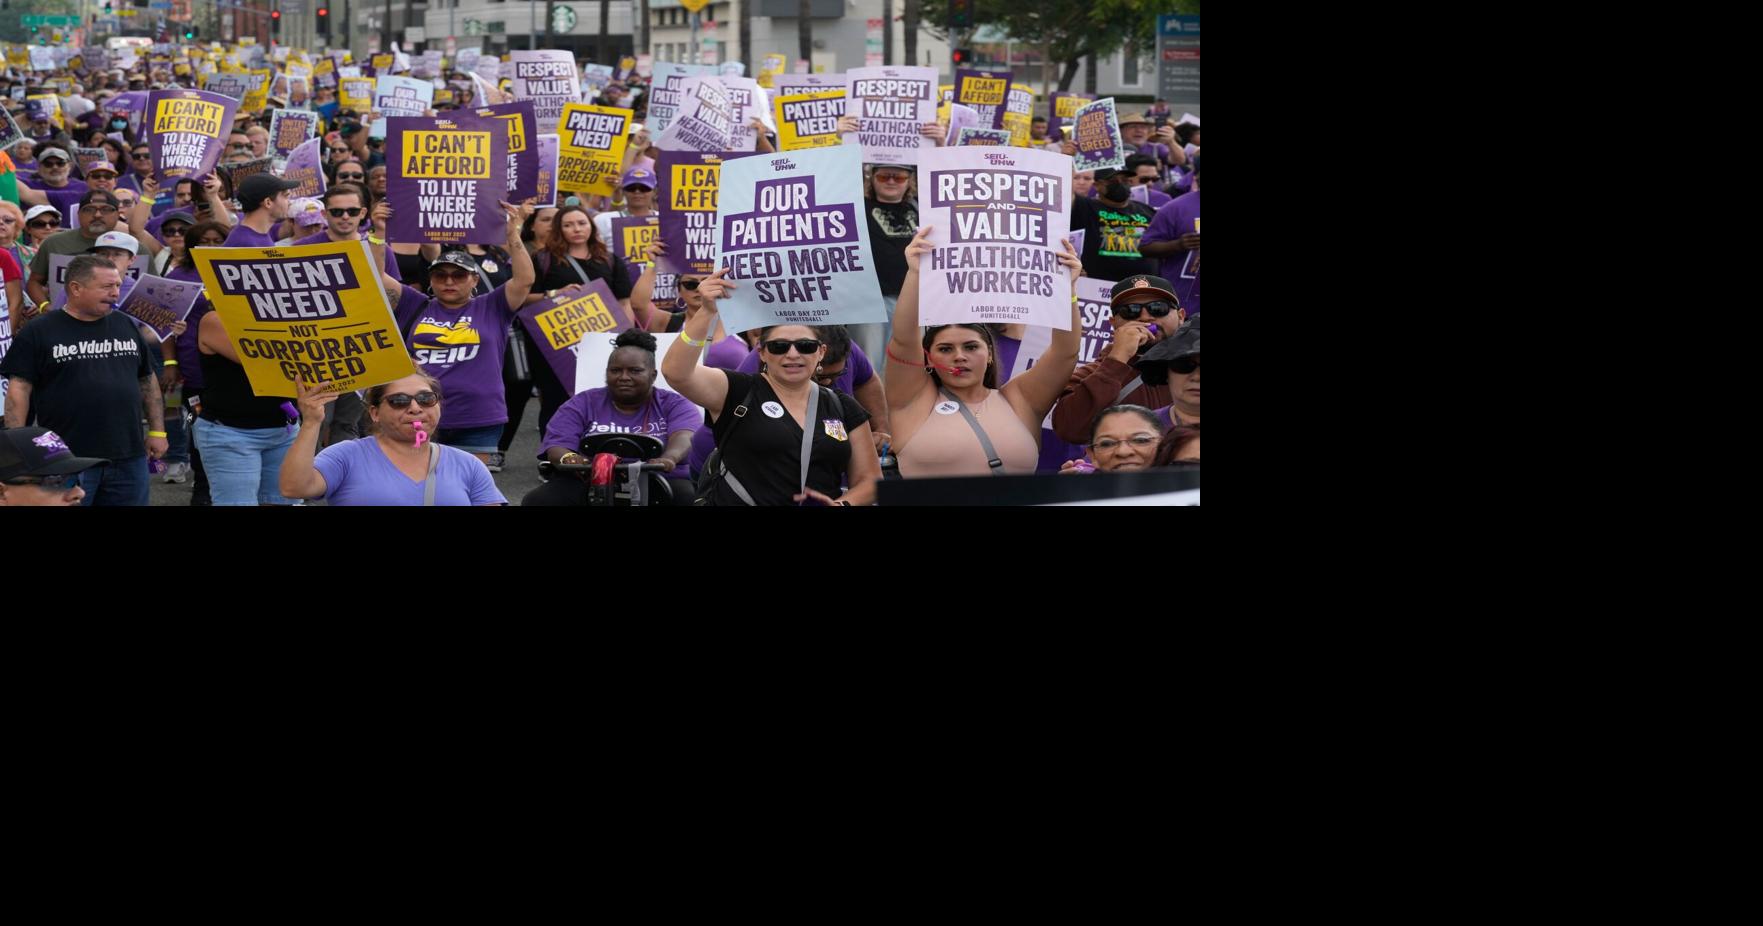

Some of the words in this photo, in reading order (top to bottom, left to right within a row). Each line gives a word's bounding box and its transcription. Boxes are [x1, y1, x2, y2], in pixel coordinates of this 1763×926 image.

[528, 80, 570, 95] VALUE
[856, 80, 928, 98] RESPECT
[164, 101, 169, 114] I
[172, 101, 220, 119] CAN'T
[784, 99, 846, 120] PATIENT
[865, 101, 915, 119] VALUE
[158, 116, 216, 134] AFFORD
[568, 112, 624, 134] PATIENT
[676, 116, 728, 149] HEALTHCAR
[796, 116, 837, 136] NEED
[860, 120, 922, 135] EALTHCAR
[162, 133, 176, 144] TO
[180, 134, 208, 146] LIVE
[414, 134, 420, 152] I
[425, 134, 485, 154] CAN'T
[572, 130, 611, 149] NEED
[858, 134, 920, 149] WORKERS
[1080, 139, 1112, 152] GREED
[162, 144, 204, 158] WHERE
[160, 157, 164, 168] I
[166, 156, 202, 170] WORK
[407, 156, 486, 176] AFFORD
[558, 156, 619, 175] ORPORATE
[558, 169, 600, 184] GREED
[682, 168, 686, 186] I
[418, 180, 438, 196] TO
[442, 180, 477, 196] LIVE
[760, 182, 808, 213] OUR
[938, 173, 1057, 206] RESPECT
[418, 196, 476, 212] WHERE
[676, 189, 718, 208] AFFO
[986, 202, 1016, 210] AND
[419, 212, 424, 228] I
[428, 212, 476, 228] WORK
[684, 212, 704, 228] TO
[730, 210, 846, 246] PATIENTS
[955, 212, 1043, 242] VALUE
[632, 230, 636, 243] I
[686, 244, 690, 260] I
[694, 244, 716, 260] WO
[722, 251, 782, 280] NEED
[788, 246, 864, 276] MORE
[218, 258, 347, 290] PATIENT
[754, 276, 832, 303] STAFF
[946, 271, 1053, 297] WORKERS
[252, 290, 338, 319] NEED
[544, 315, 555, 328] I
[553, 296, 599, 325] CAN'T
[290, 324, 318, 337] NOT
[552, 313, 610, 346] AFFORD
[1088, 330, 1110, 339] AND
[53, 344, 78, 358] the
[79, 340, 112, 354] Vdub
[113, 338, 137, 352] hub
[239, 328, 394, 361] CORPORATE
[415, 345, 480, 365] SEIU
[279, 357, 366, 384] GREED
